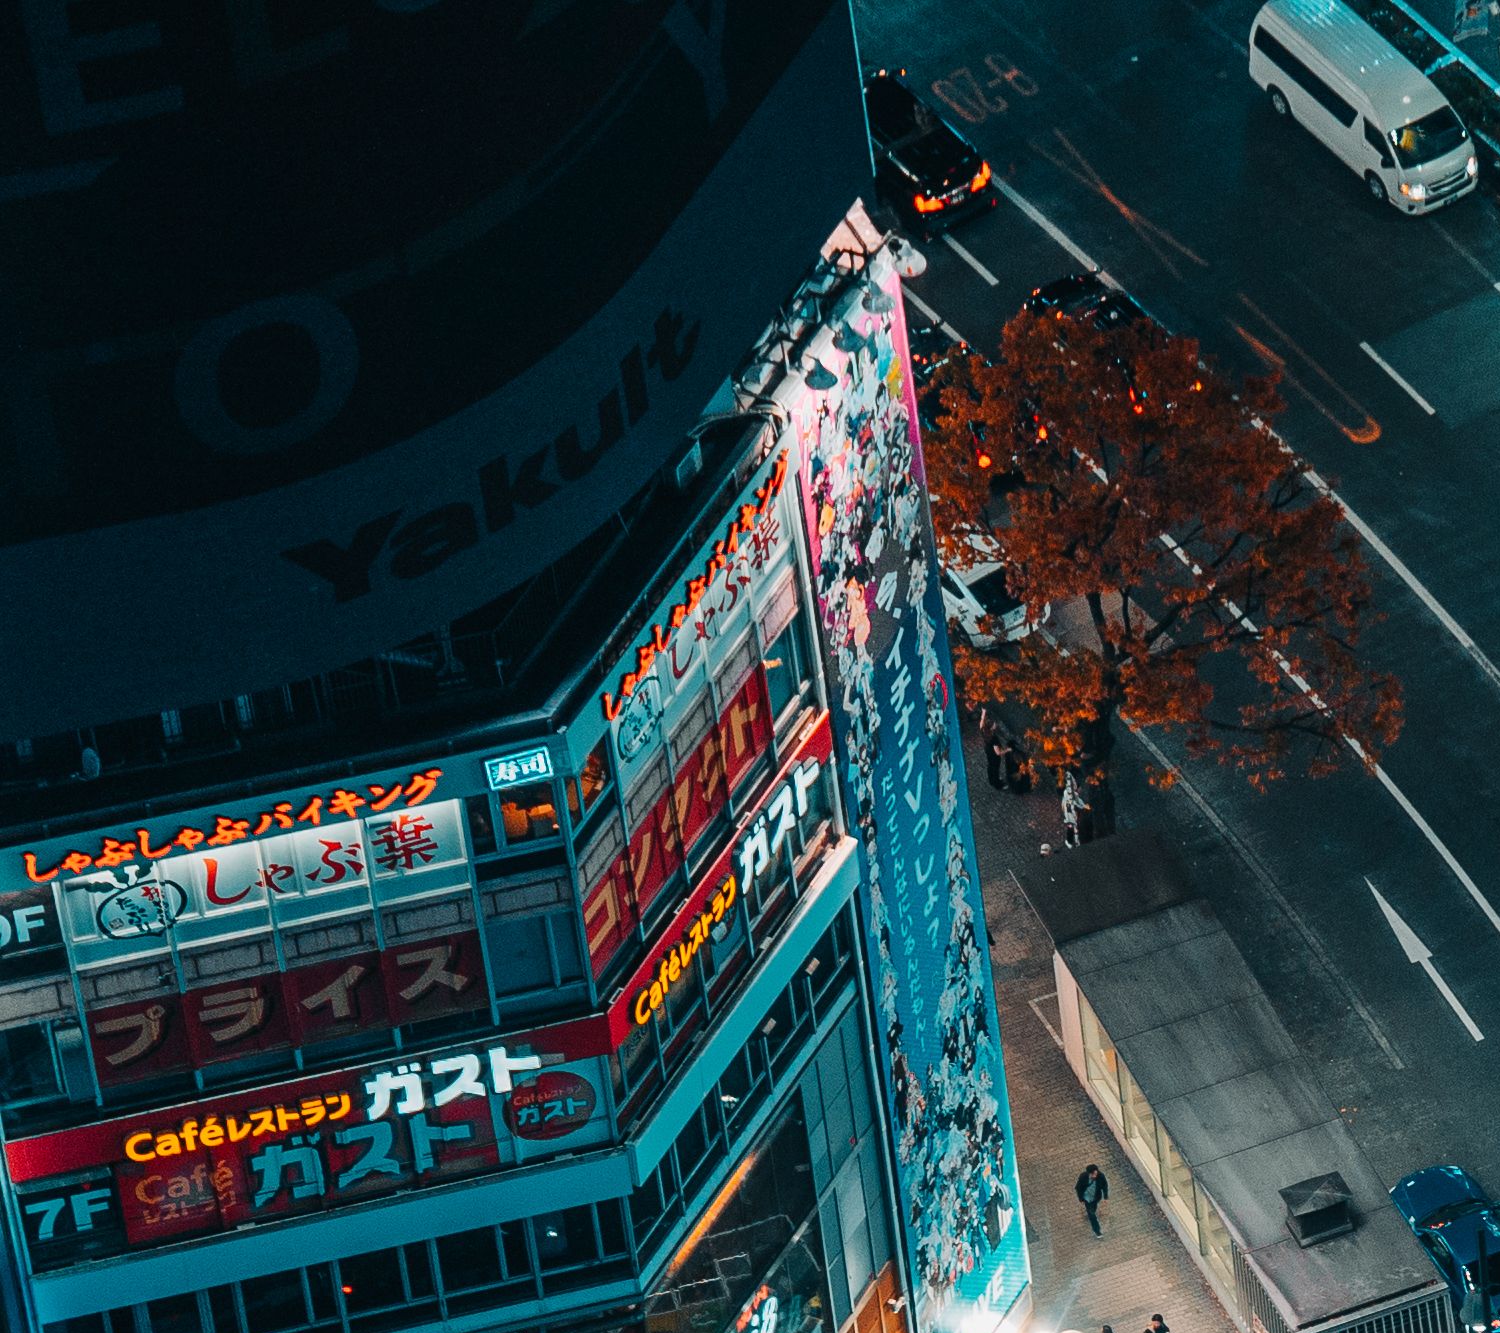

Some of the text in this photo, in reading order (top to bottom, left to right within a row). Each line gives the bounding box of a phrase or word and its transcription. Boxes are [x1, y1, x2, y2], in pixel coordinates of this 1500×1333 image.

[280, 304, 702, 604] Yakult
[491, 750, 549, 784] 寿司
[22, 767, 443, 884] しゃぶしゃぶバイキング
[203, 814, 439, 905] しゃぶ葉
[586, 692, 760, 953] コンタクト
[739, 762, 821, 894] ガスト
[94, 945, 470, 1066] プライス
[124, 1092, 352, 1163] Caféレストラン
[364, 1046, 542, 1122] ガスト
[517, 1095, 588, 1127] ガスト
[133, 1159, 234, 1206] Café
[251, 1114, 473, 1209] ガスト
[25, 1187, 112, 1241] 7F
